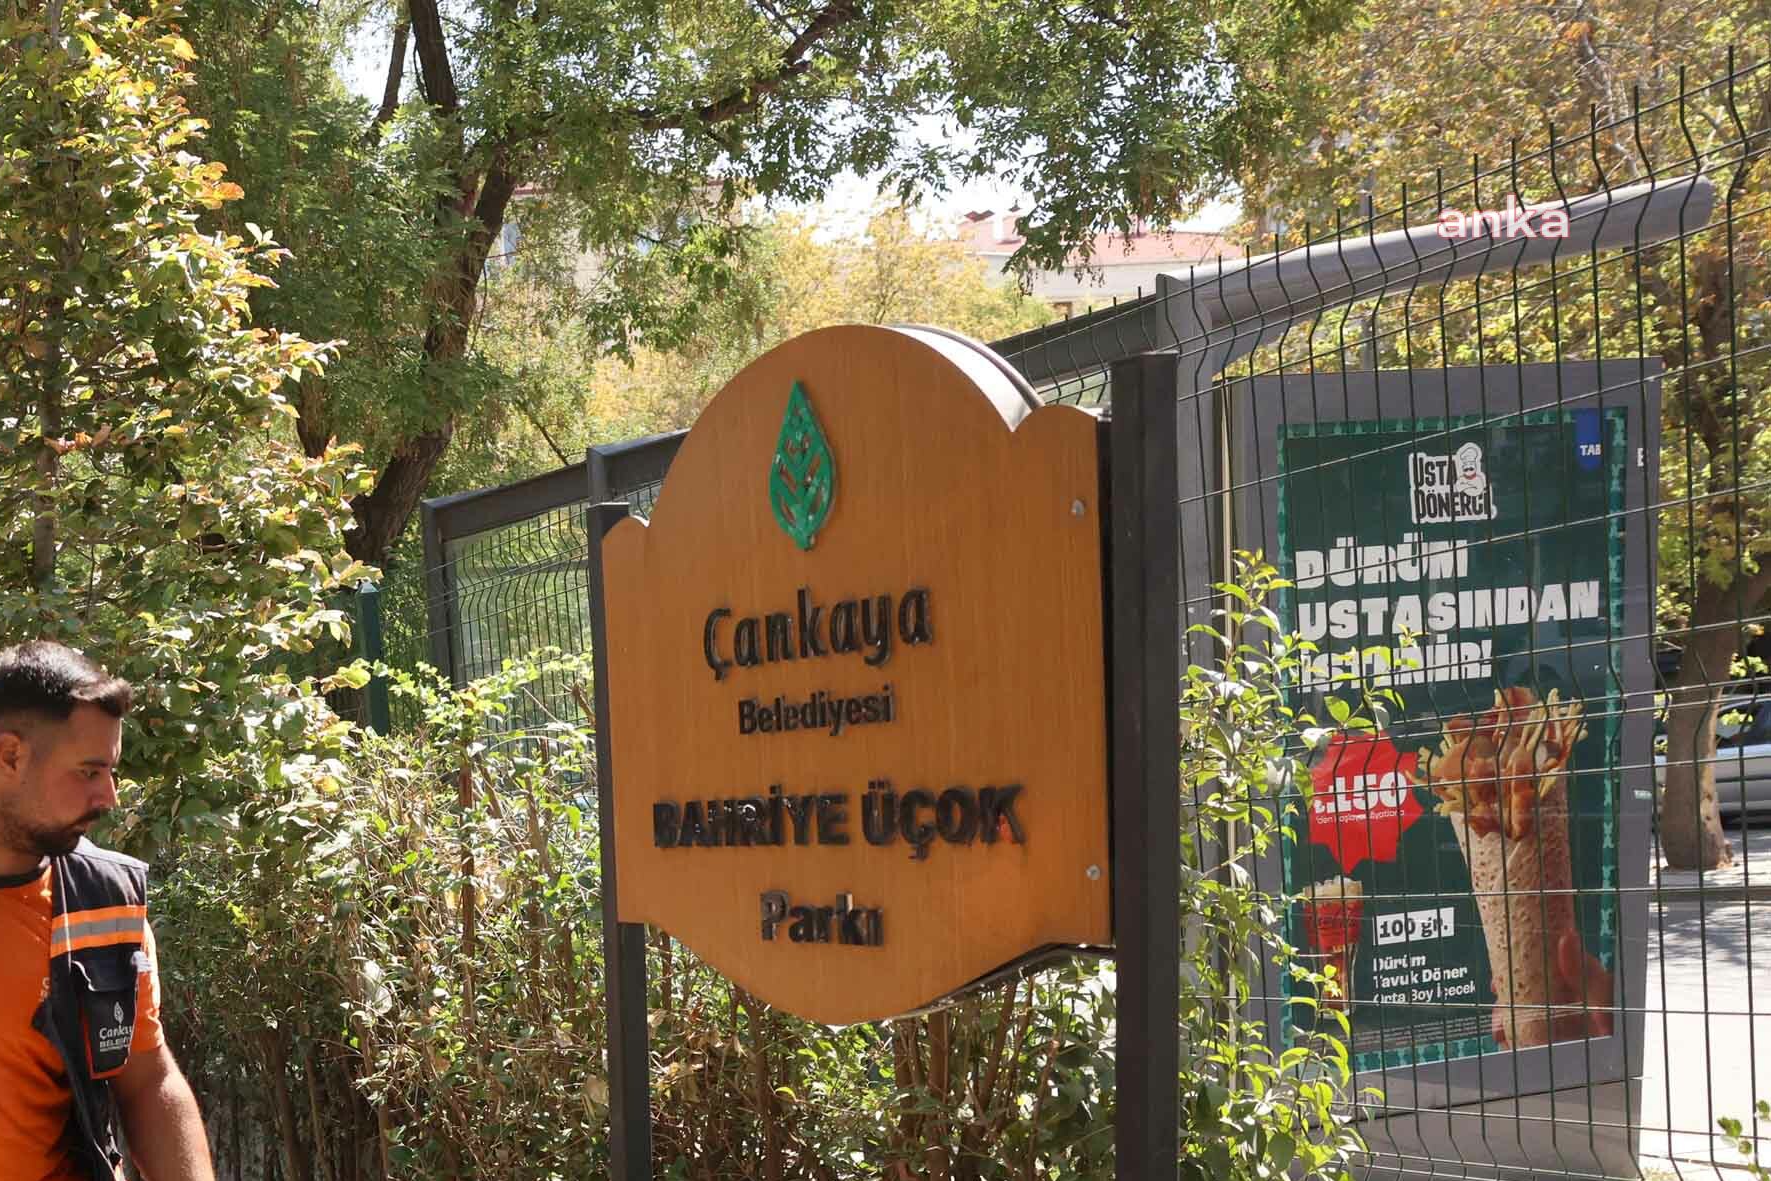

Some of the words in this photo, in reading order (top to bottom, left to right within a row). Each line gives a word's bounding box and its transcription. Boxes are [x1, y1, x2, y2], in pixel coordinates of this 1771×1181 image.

[1412, 456, 1458, 488] USTA
[1414, 487, 1491, 519] DÖNERCİ
[1295, 531, 1468, 589] DÜRÜM
[704, 585, 932, 680] Çankaya
[1297, 580, 1600, 641] USTASINDAN
[738, 684, 895, 736] Belediyesi
[652, 784, 850, 848] BAHRİYE
[861, 778, 1026, 860] ÜÇOK
[760, 889, 884, 947] Parkı
[1380, 918, 1415, 938] 100
[1373, 970, 1419, 989] Tavuk
[1422, 966, 1468, 982] Döner
